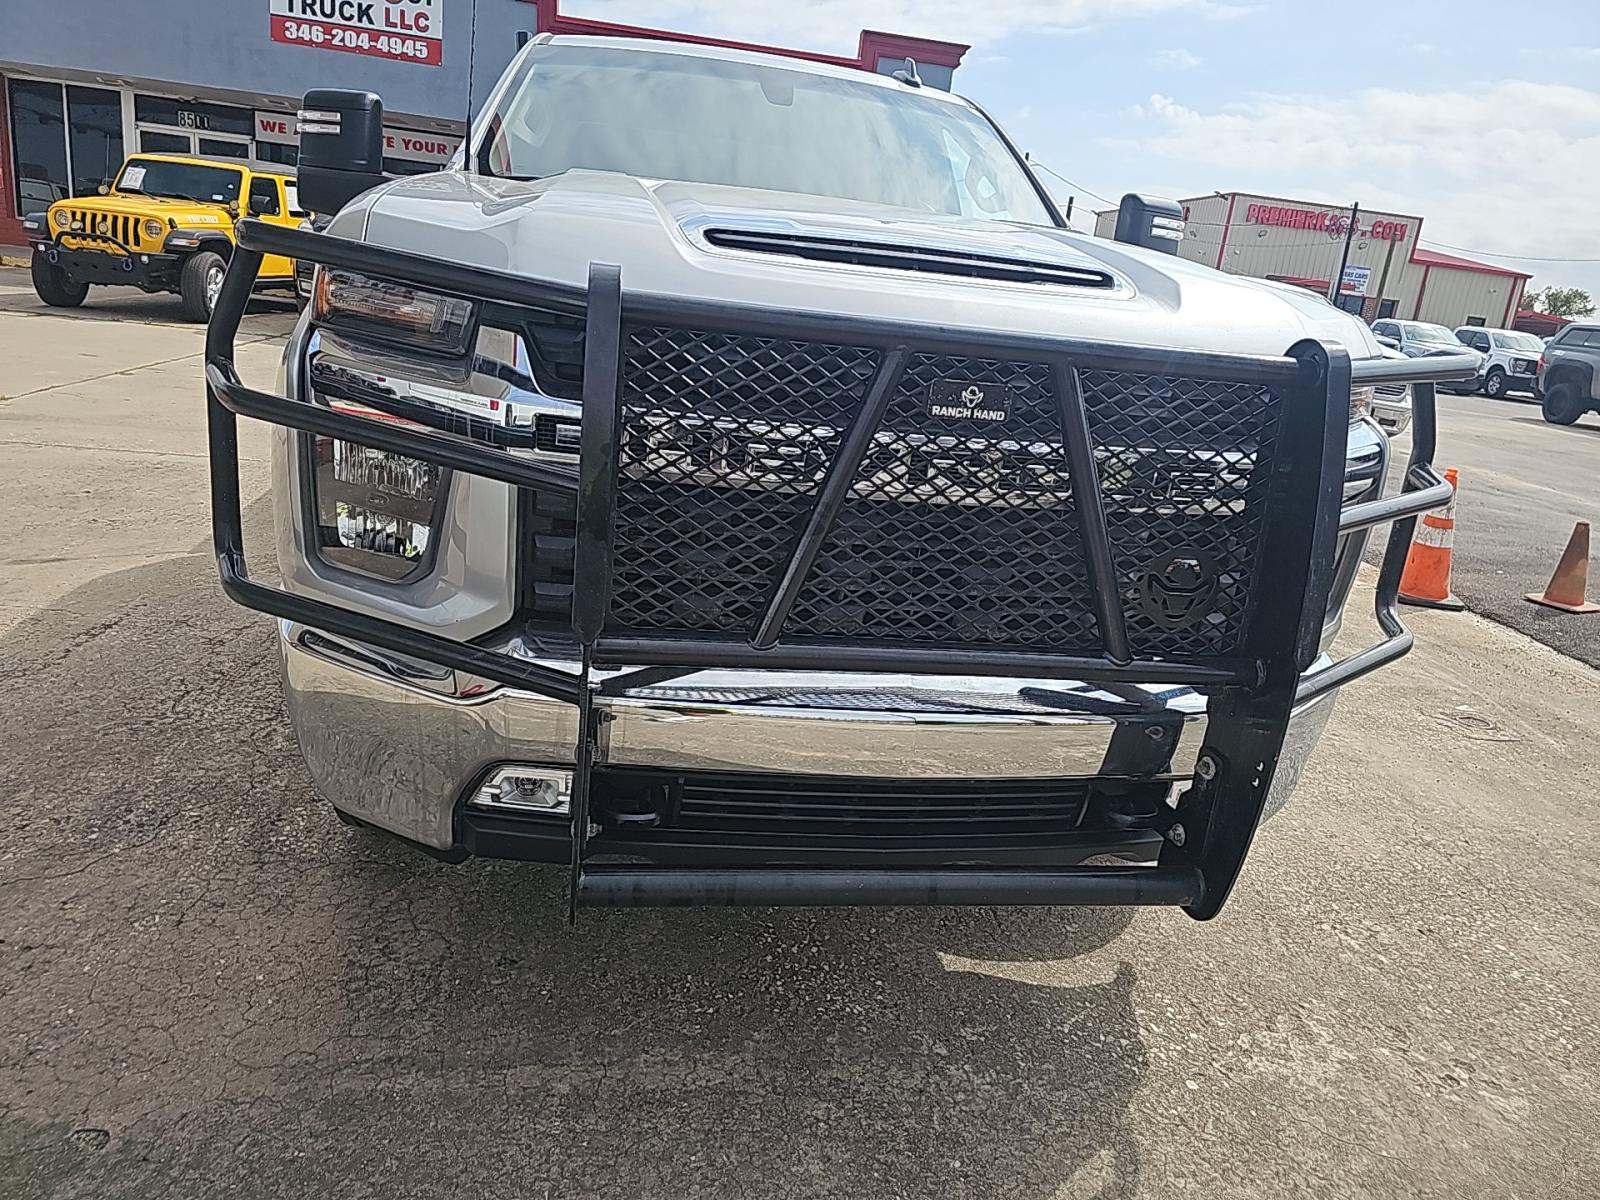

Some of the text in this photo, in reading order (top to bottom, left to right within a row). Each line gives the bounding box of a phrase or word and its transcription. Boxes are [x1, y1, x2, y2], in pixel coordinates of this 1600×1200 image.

[384, 7, 430, 33] LLC
[284, 21, 429, 59] 346-204-4945
[260, 120, 287, 134] WE
[401, 137, 448, 155] YOUR
[932, 405, 1006, 421] RANCH HAND
